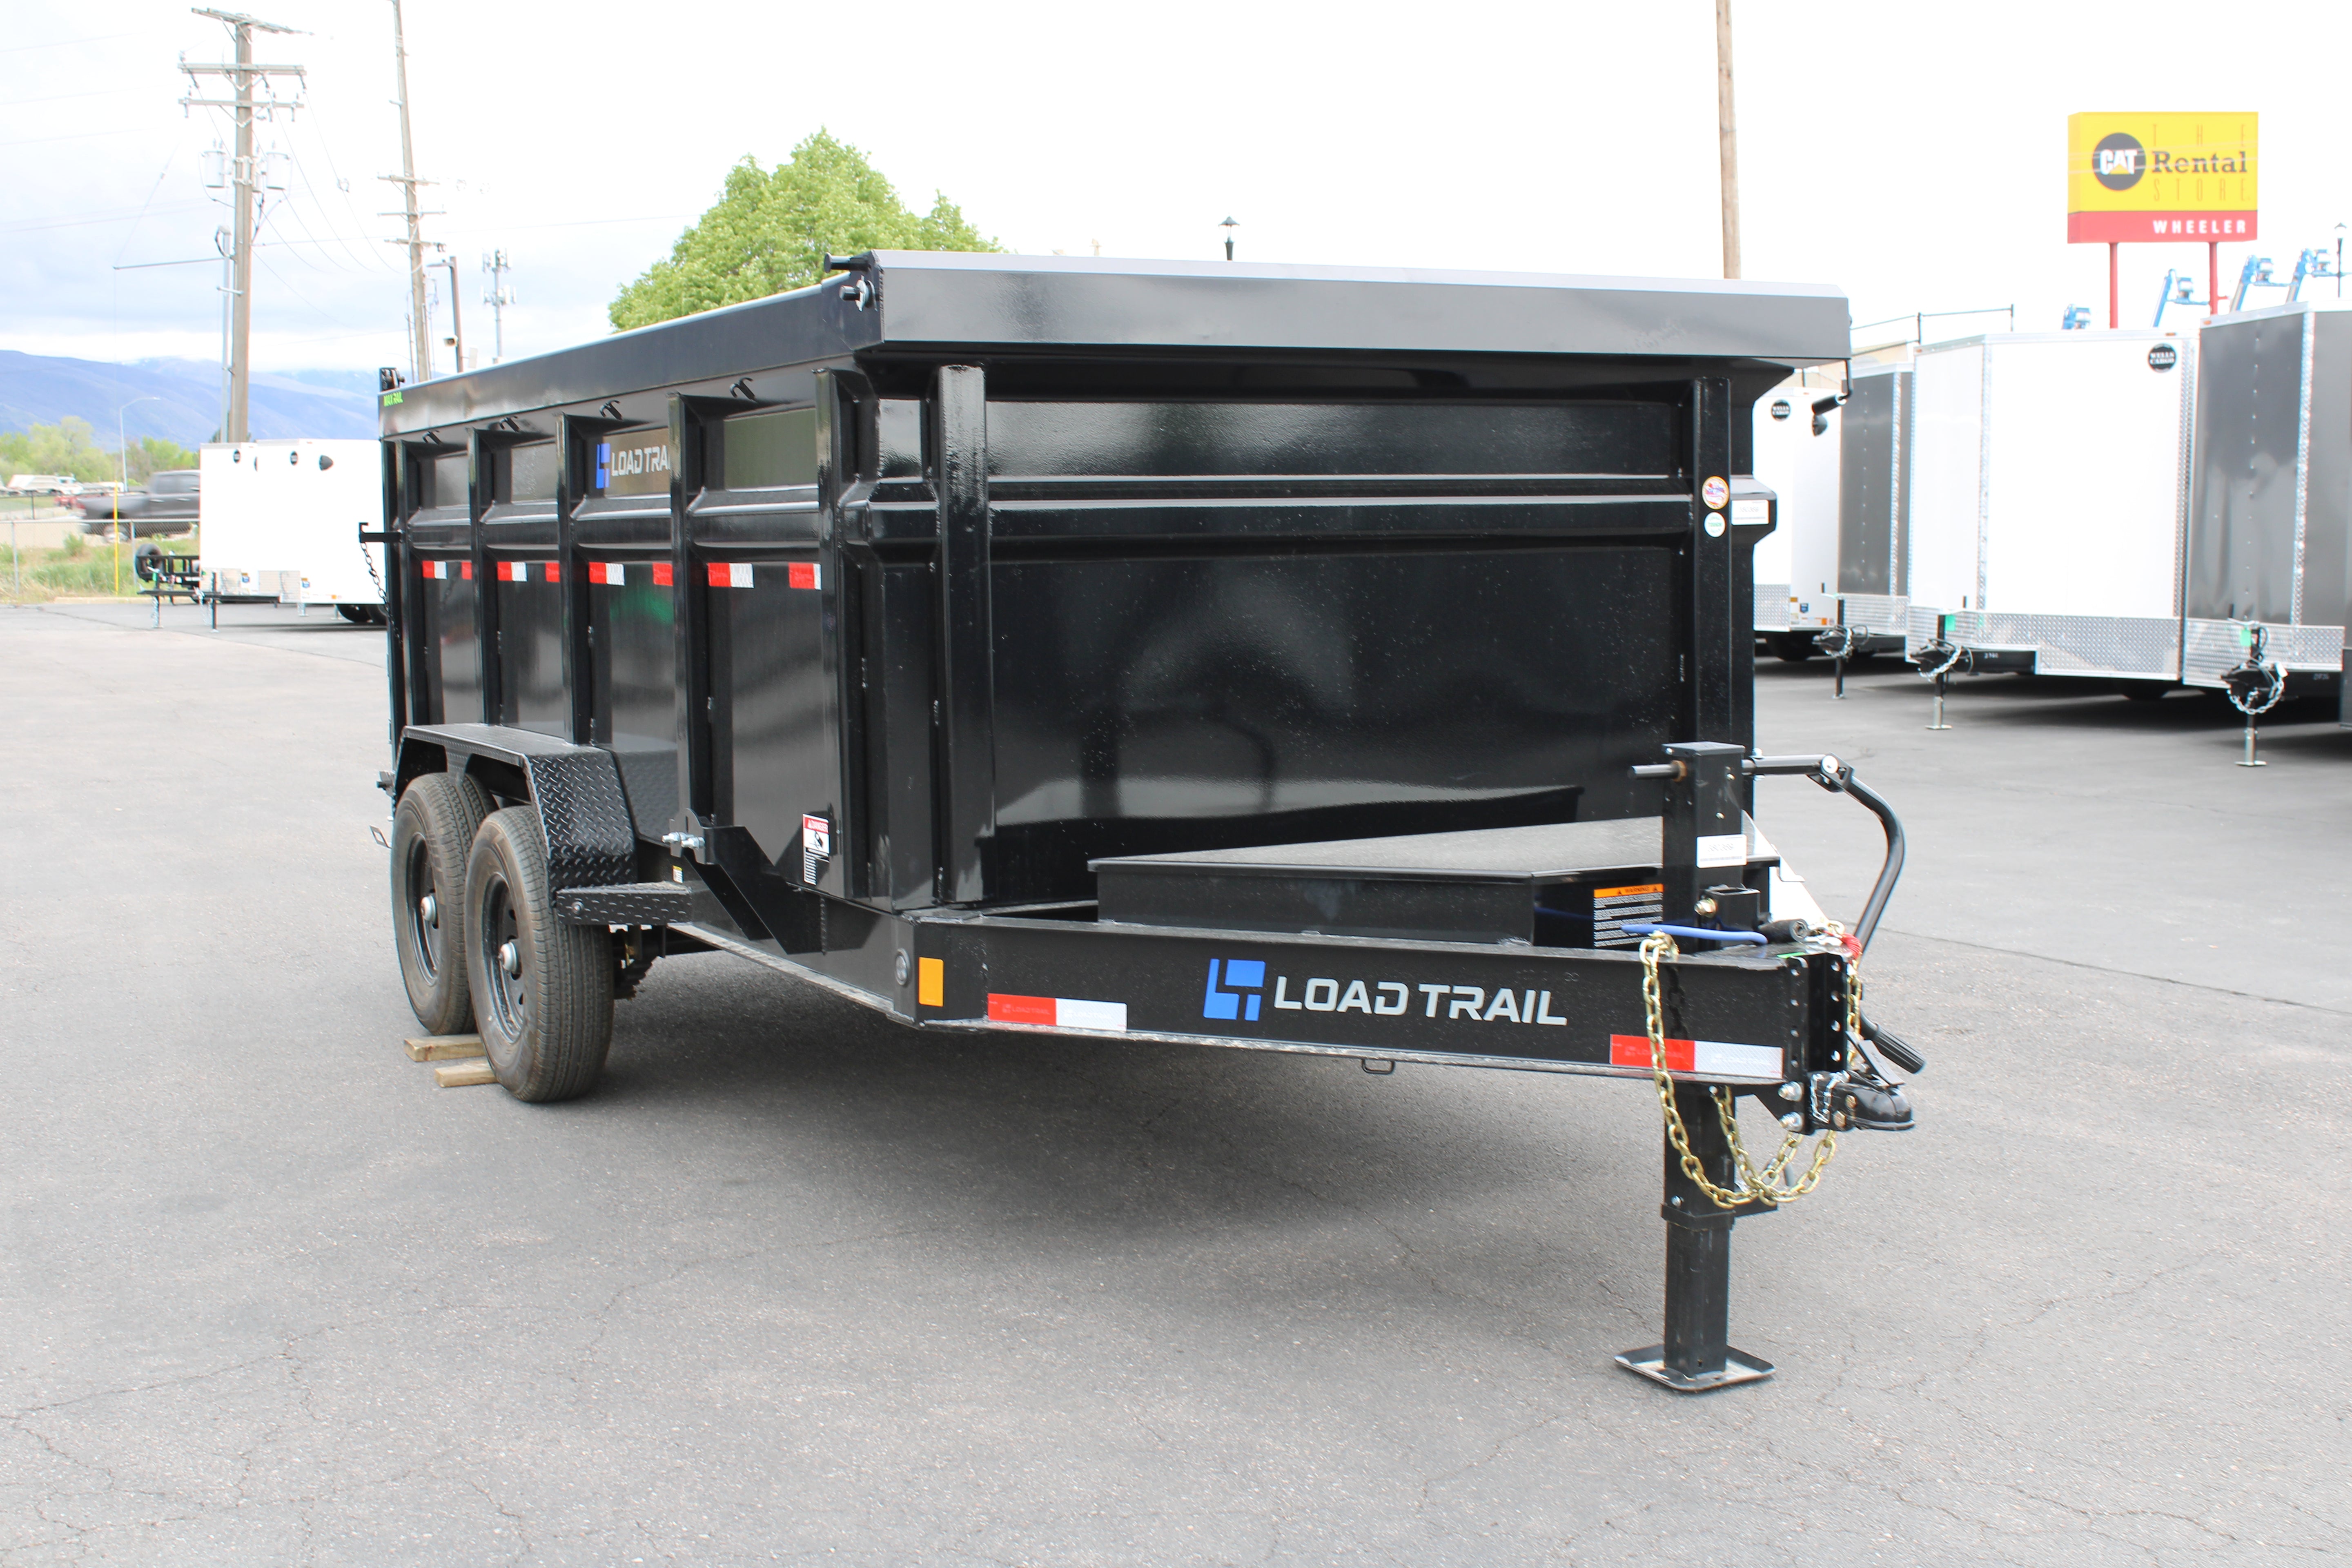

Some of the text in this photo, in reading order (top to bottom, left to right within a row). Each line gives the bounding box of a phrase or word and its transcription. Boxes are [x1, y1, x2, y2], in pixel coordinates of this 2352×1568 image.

[2153, 124, 2246, 147] THE
[2099, 149, 2138, 175] CAT
[2152, 151, 2247, 173] Rental
[2152, 220, 2247, 234] WHEELER
[611, 445, 670, 477] LOAD TRA
[1274, 976, 1567, 1026] LOAD TRAIL
